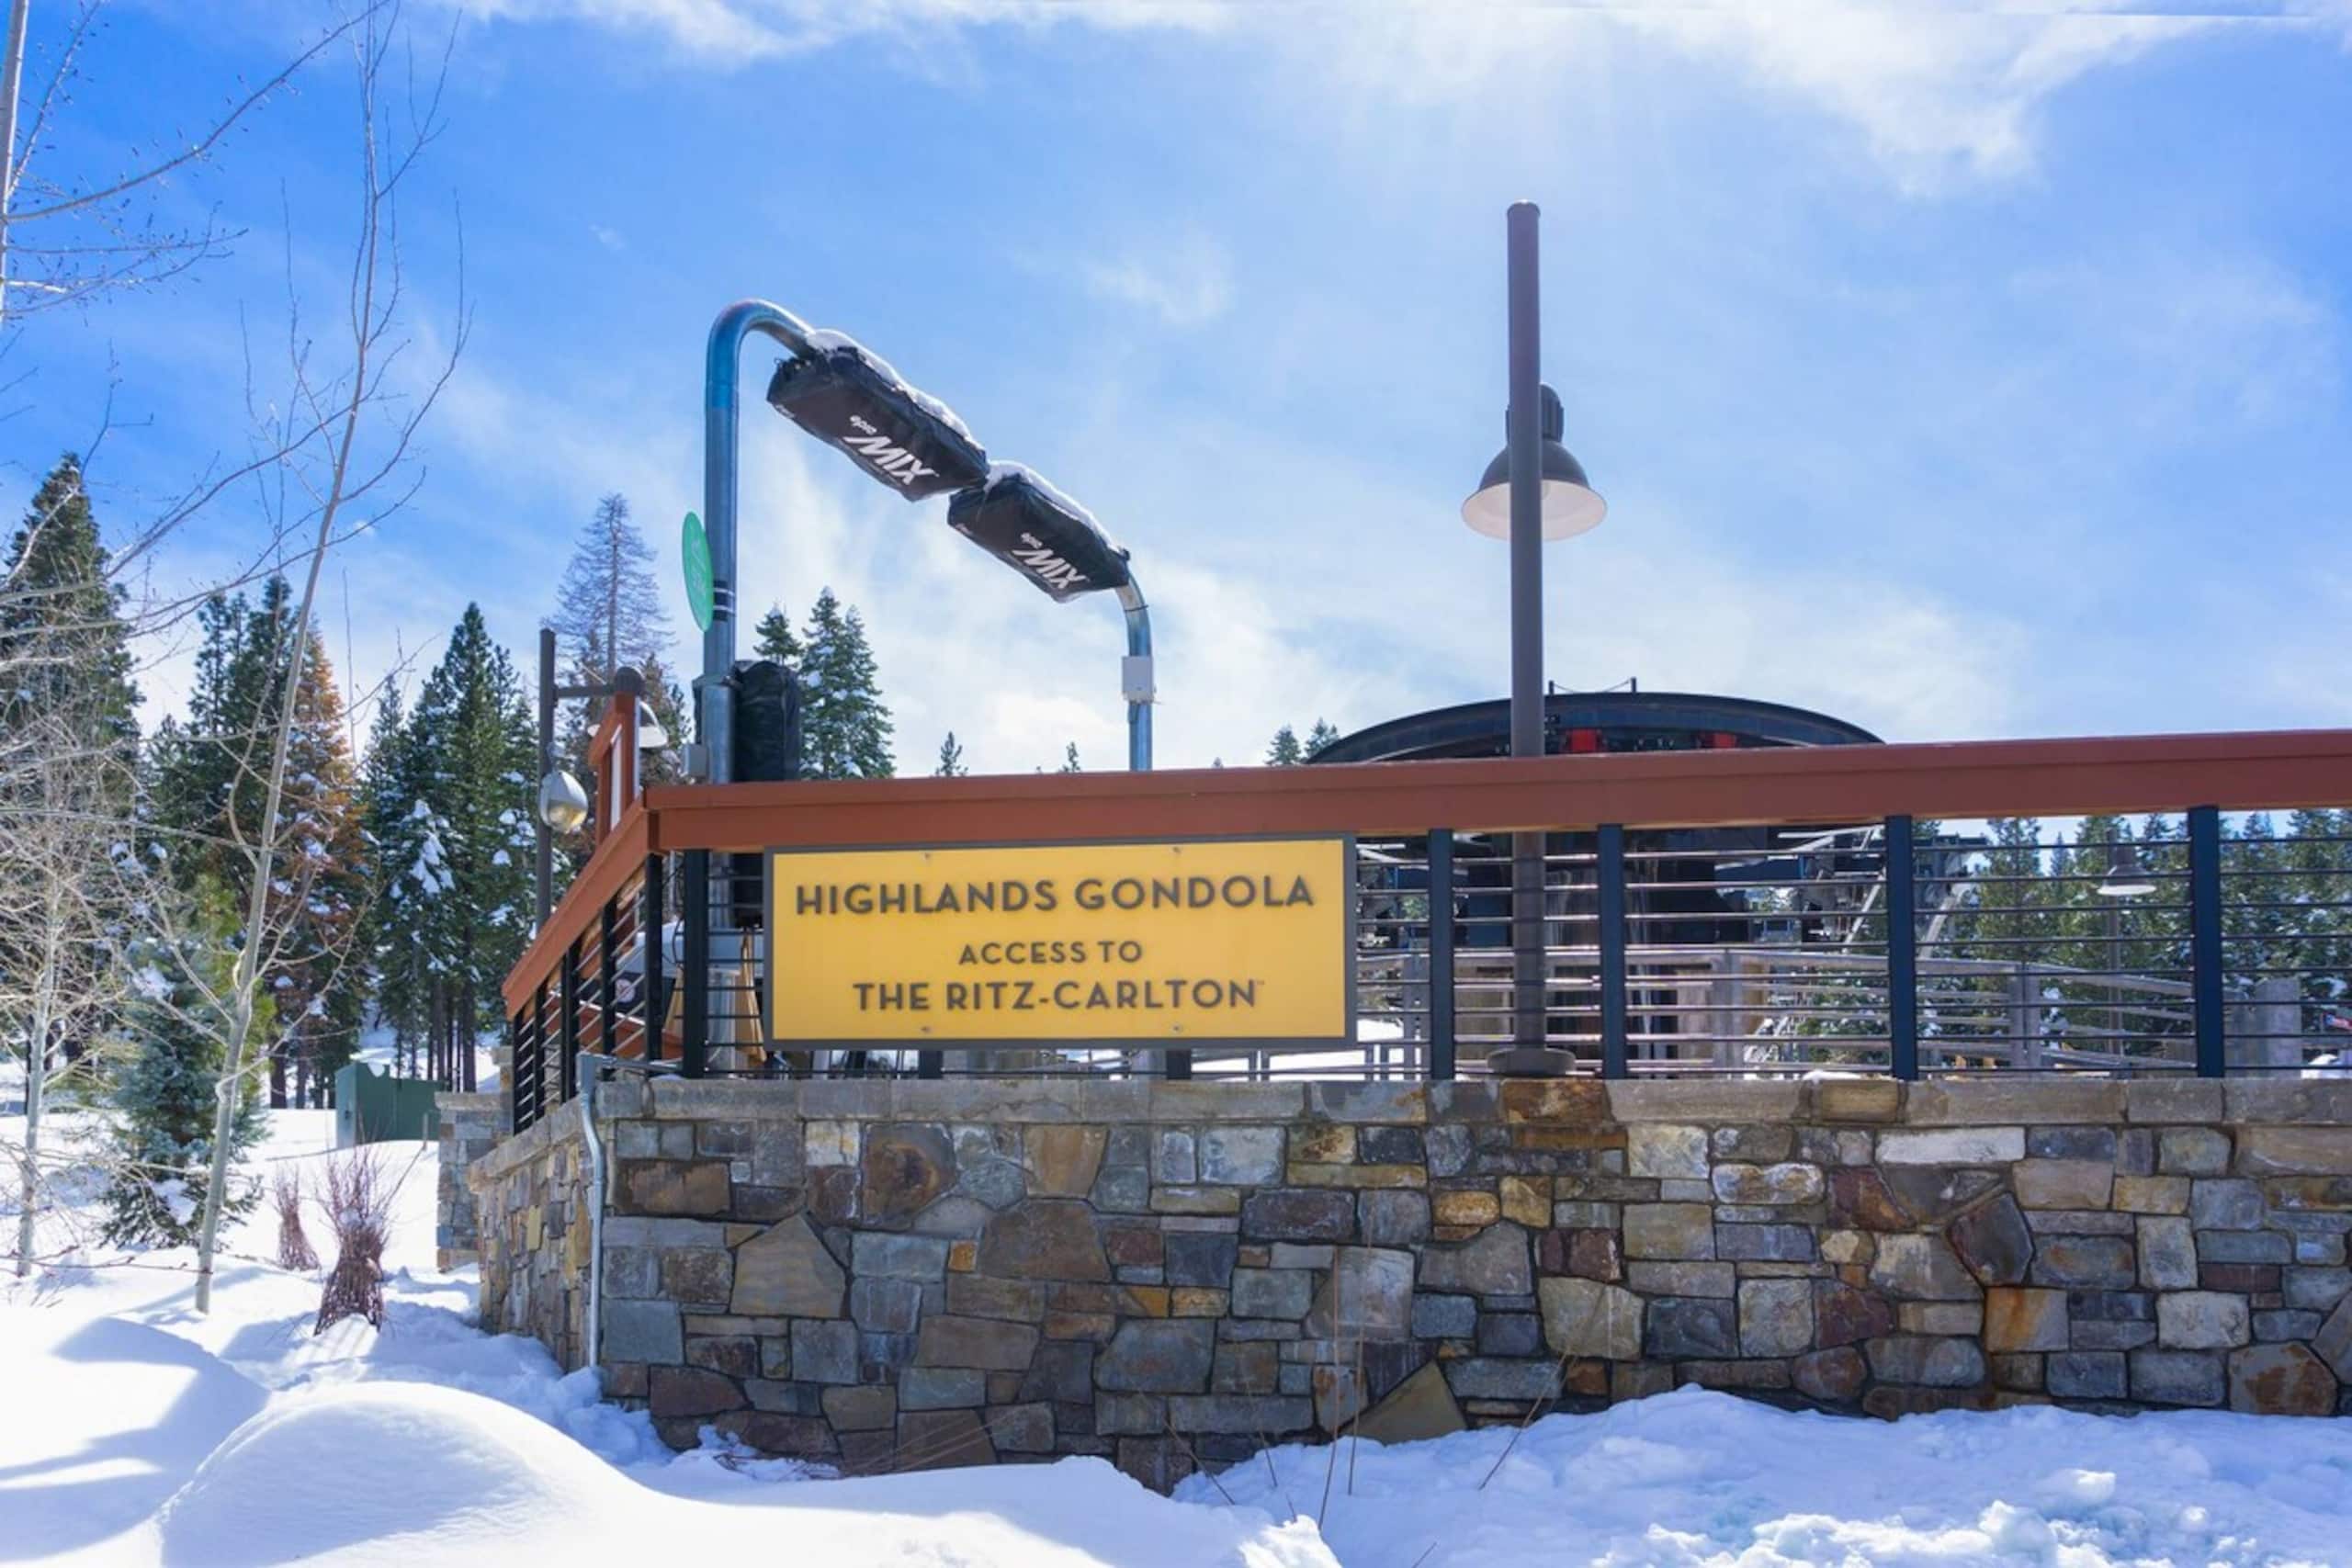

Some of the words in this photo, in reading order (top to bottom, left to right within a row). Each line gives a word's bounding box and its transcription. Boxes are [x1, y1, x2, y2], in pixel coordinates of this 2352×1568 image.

[842, 436, 935, 485] MIX
[1012, 549, 1087, 589] MIX
[796, 879, 1058, 916] HIGHLANDS
[1074, 874, 1315, 911] GONDOLA
[958, 941, 1087, 965] ACCESS
[1097, 940, 1143, 964] TO
[852, 982, 932, 1012] THE
[945, 979, 1256, 1011] RITZ-CARLTON
